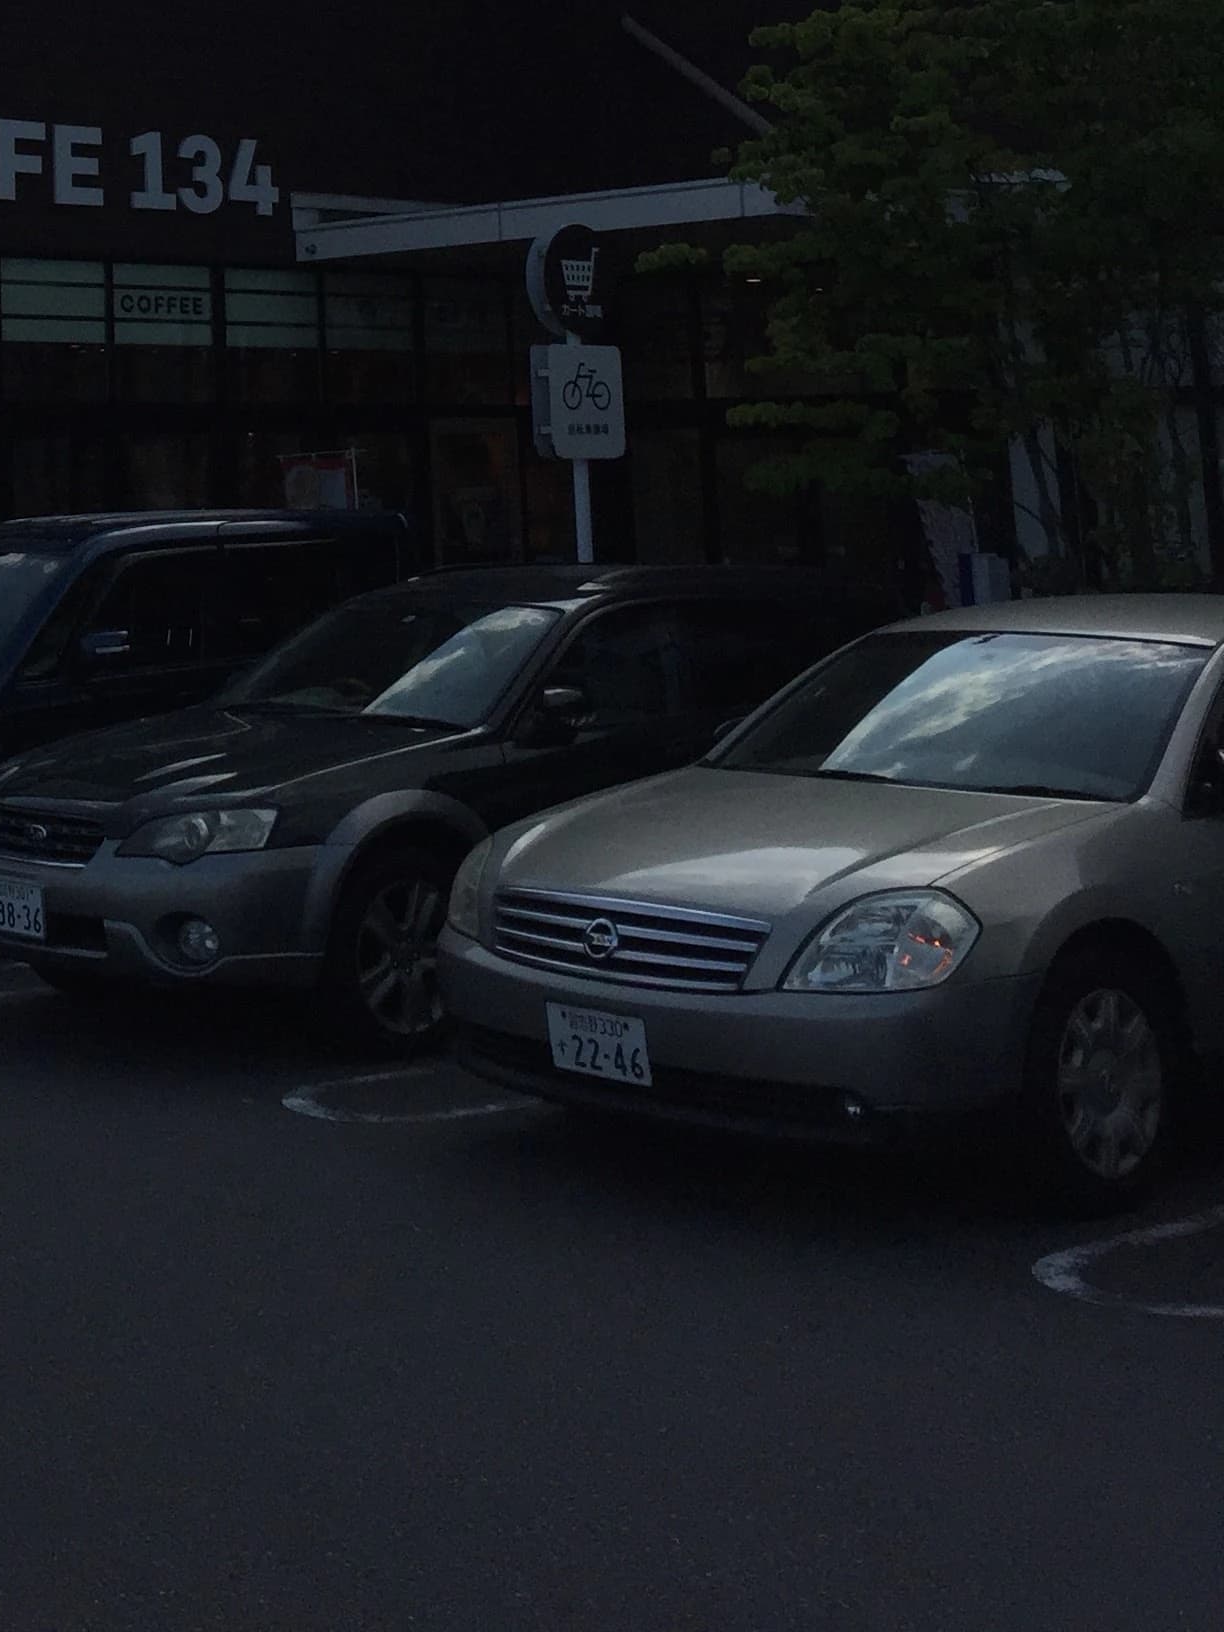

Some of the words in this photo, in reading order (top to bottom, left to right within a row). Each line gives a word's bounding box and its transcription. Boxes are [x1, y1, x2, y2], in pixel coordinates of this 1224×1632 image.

[128, 130, 279, 217] 134
[120, 293, 204, 315] COFFEE
[571, 1034, 644, 1079] 22-46
